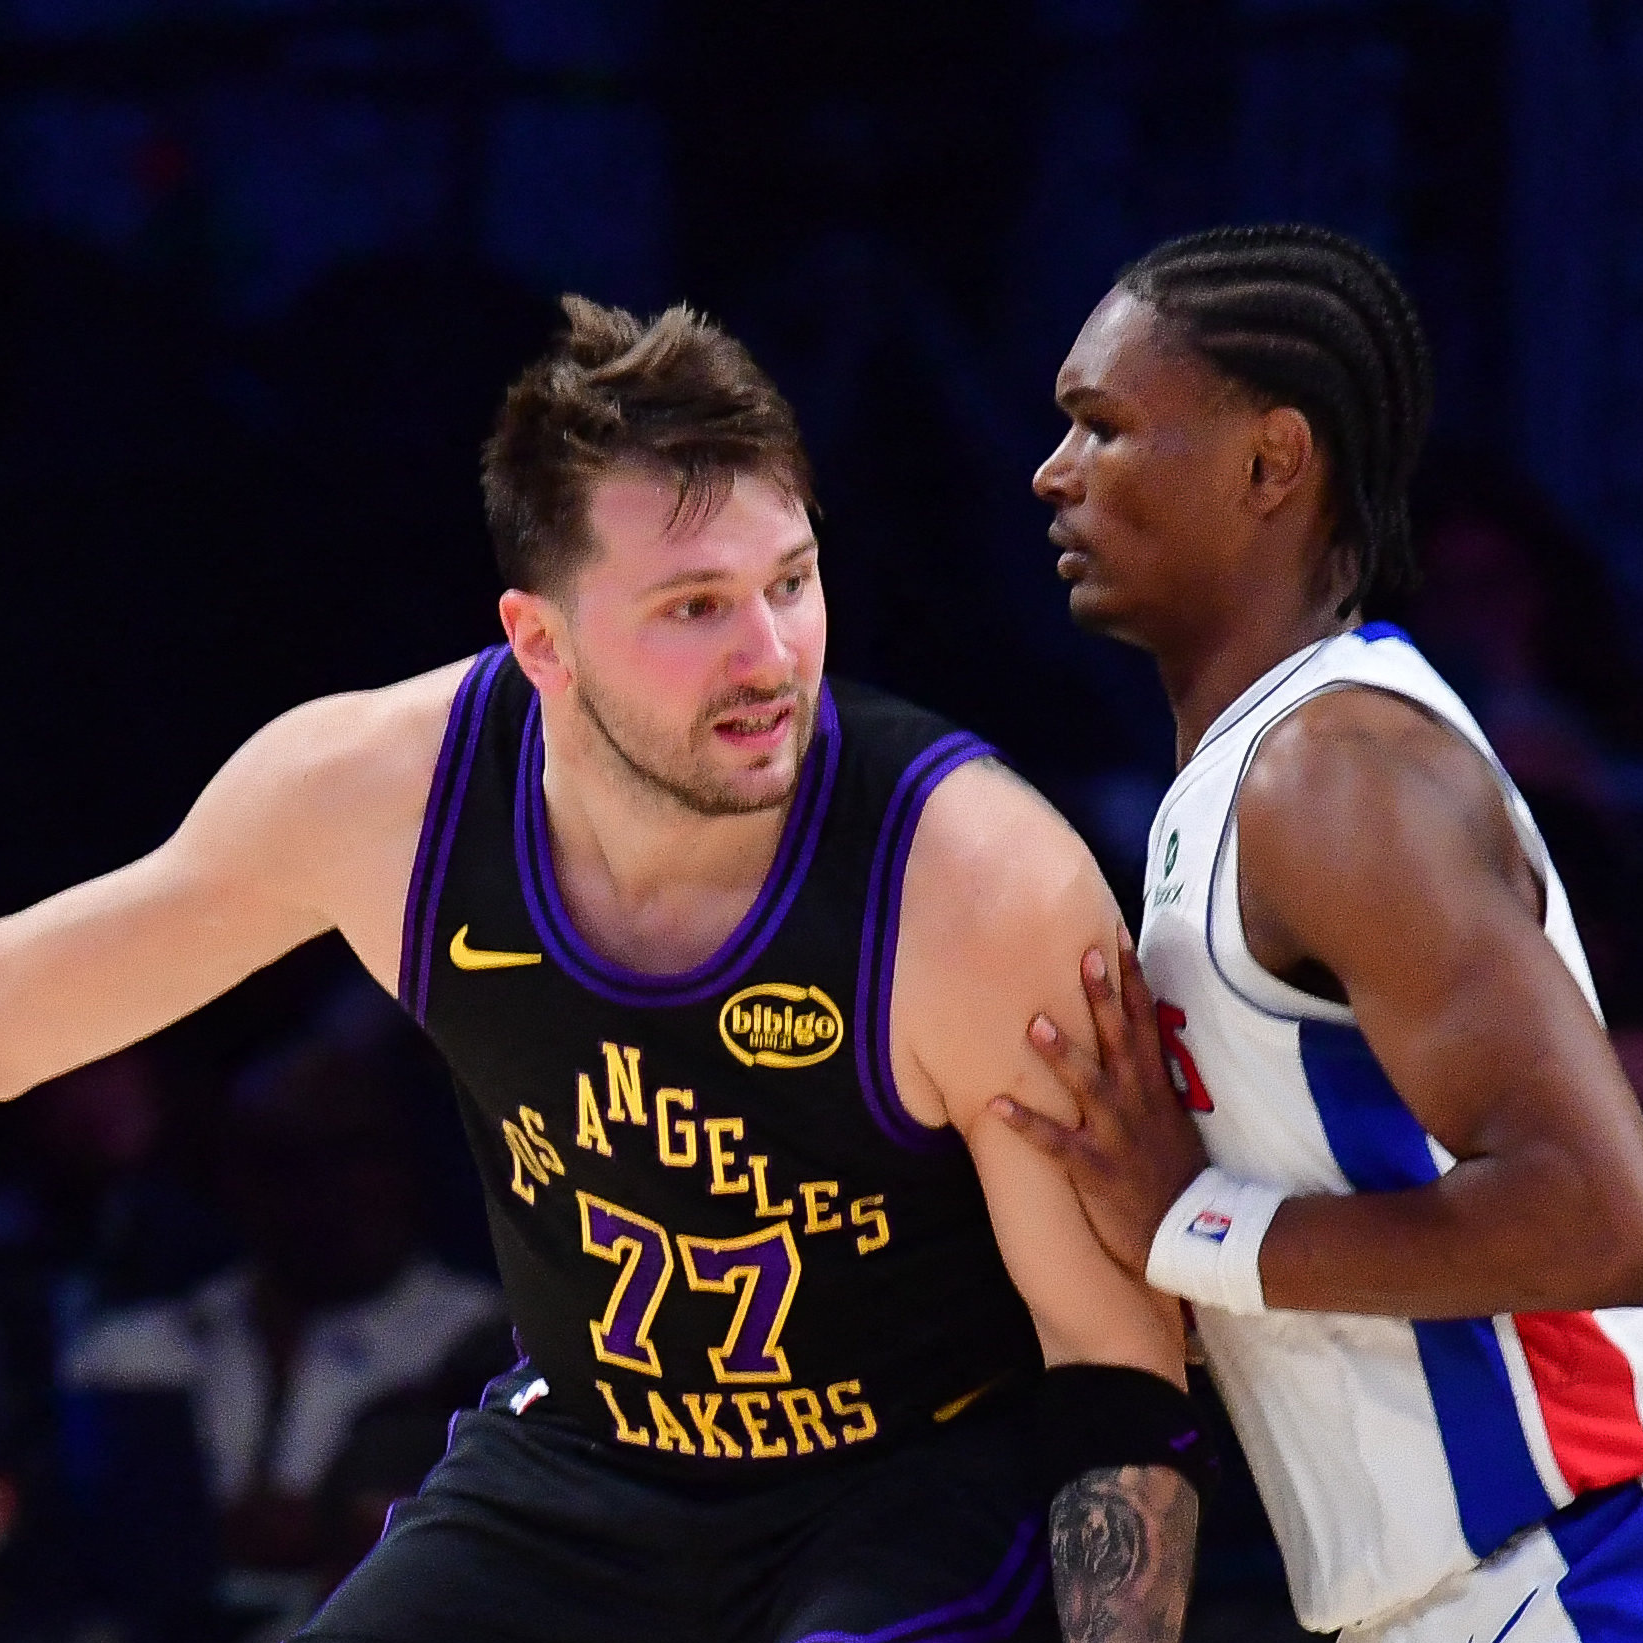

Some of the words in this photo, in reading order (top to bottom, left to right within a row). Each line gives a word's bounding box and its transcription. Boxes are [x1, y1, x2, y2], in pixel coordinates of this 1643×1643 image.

[732, 1003, 836, 1046] bibigo
[575, 1040, 891, 1256] ANGELES
[575, 1189, 803, 1384] 77
[595, 1378, 879, 1459] LAKERS
